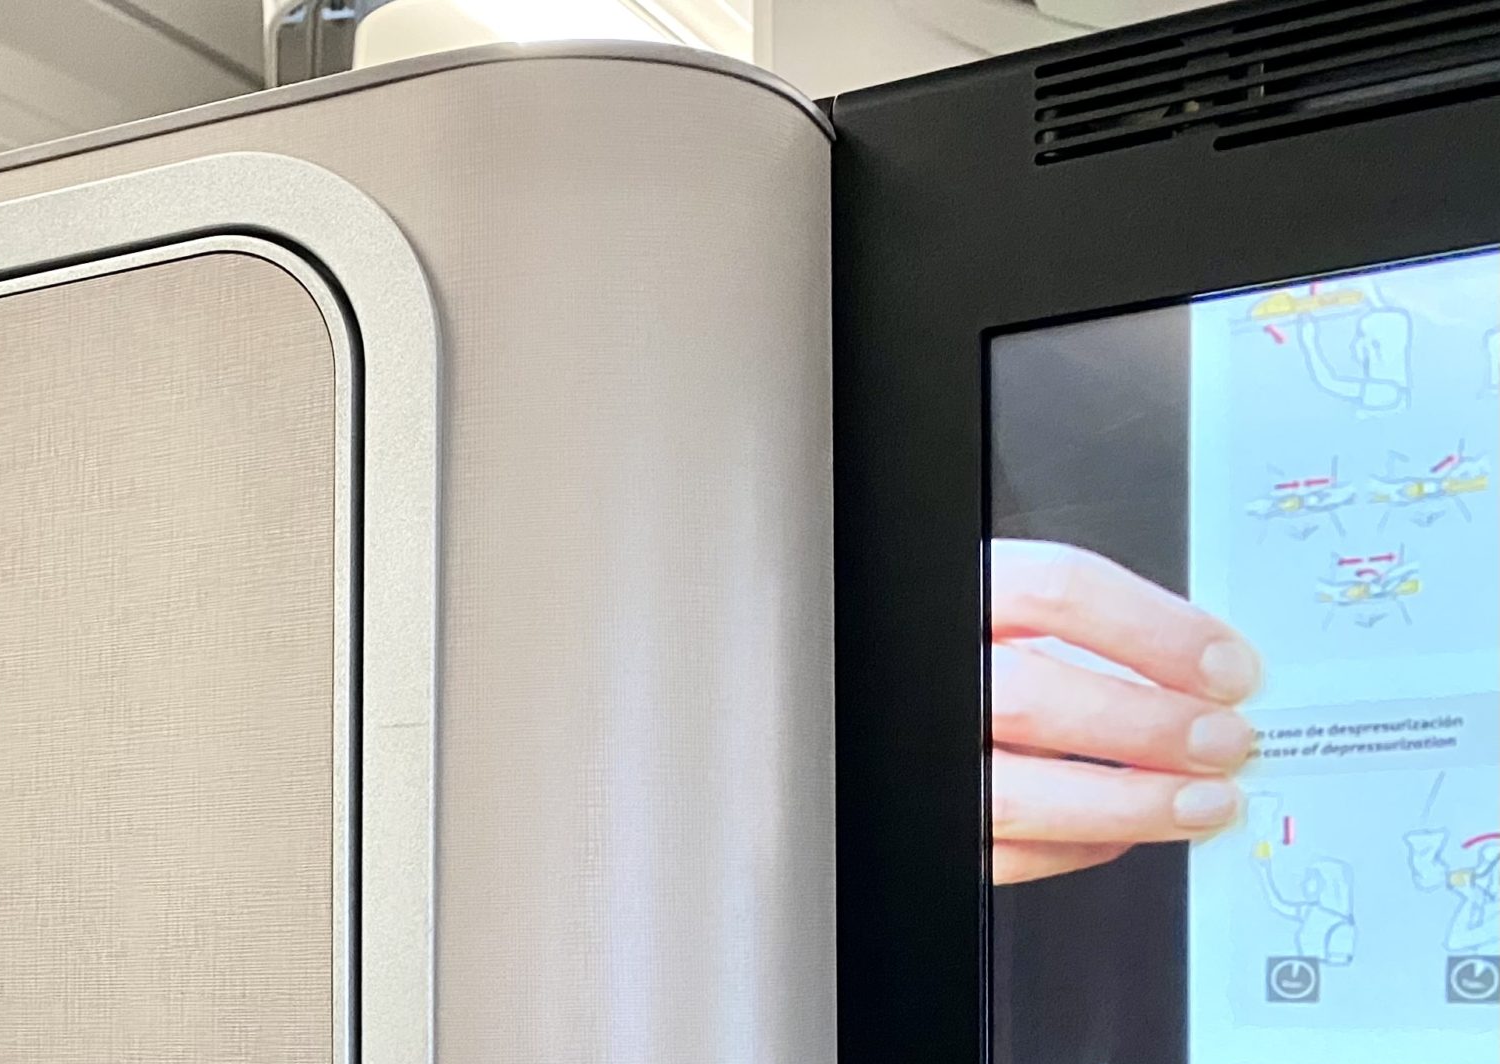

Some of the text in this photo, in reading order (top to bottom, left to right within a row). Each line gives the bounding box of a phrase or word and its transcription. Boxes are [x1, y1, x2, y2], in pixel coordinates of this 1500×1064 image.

[1306, 724, 1324, 738] de
[1264, 747, 1297, 758] case
[1301, 742, 1320, 756] of
[1321, 736, 1457, 756] depressurization
